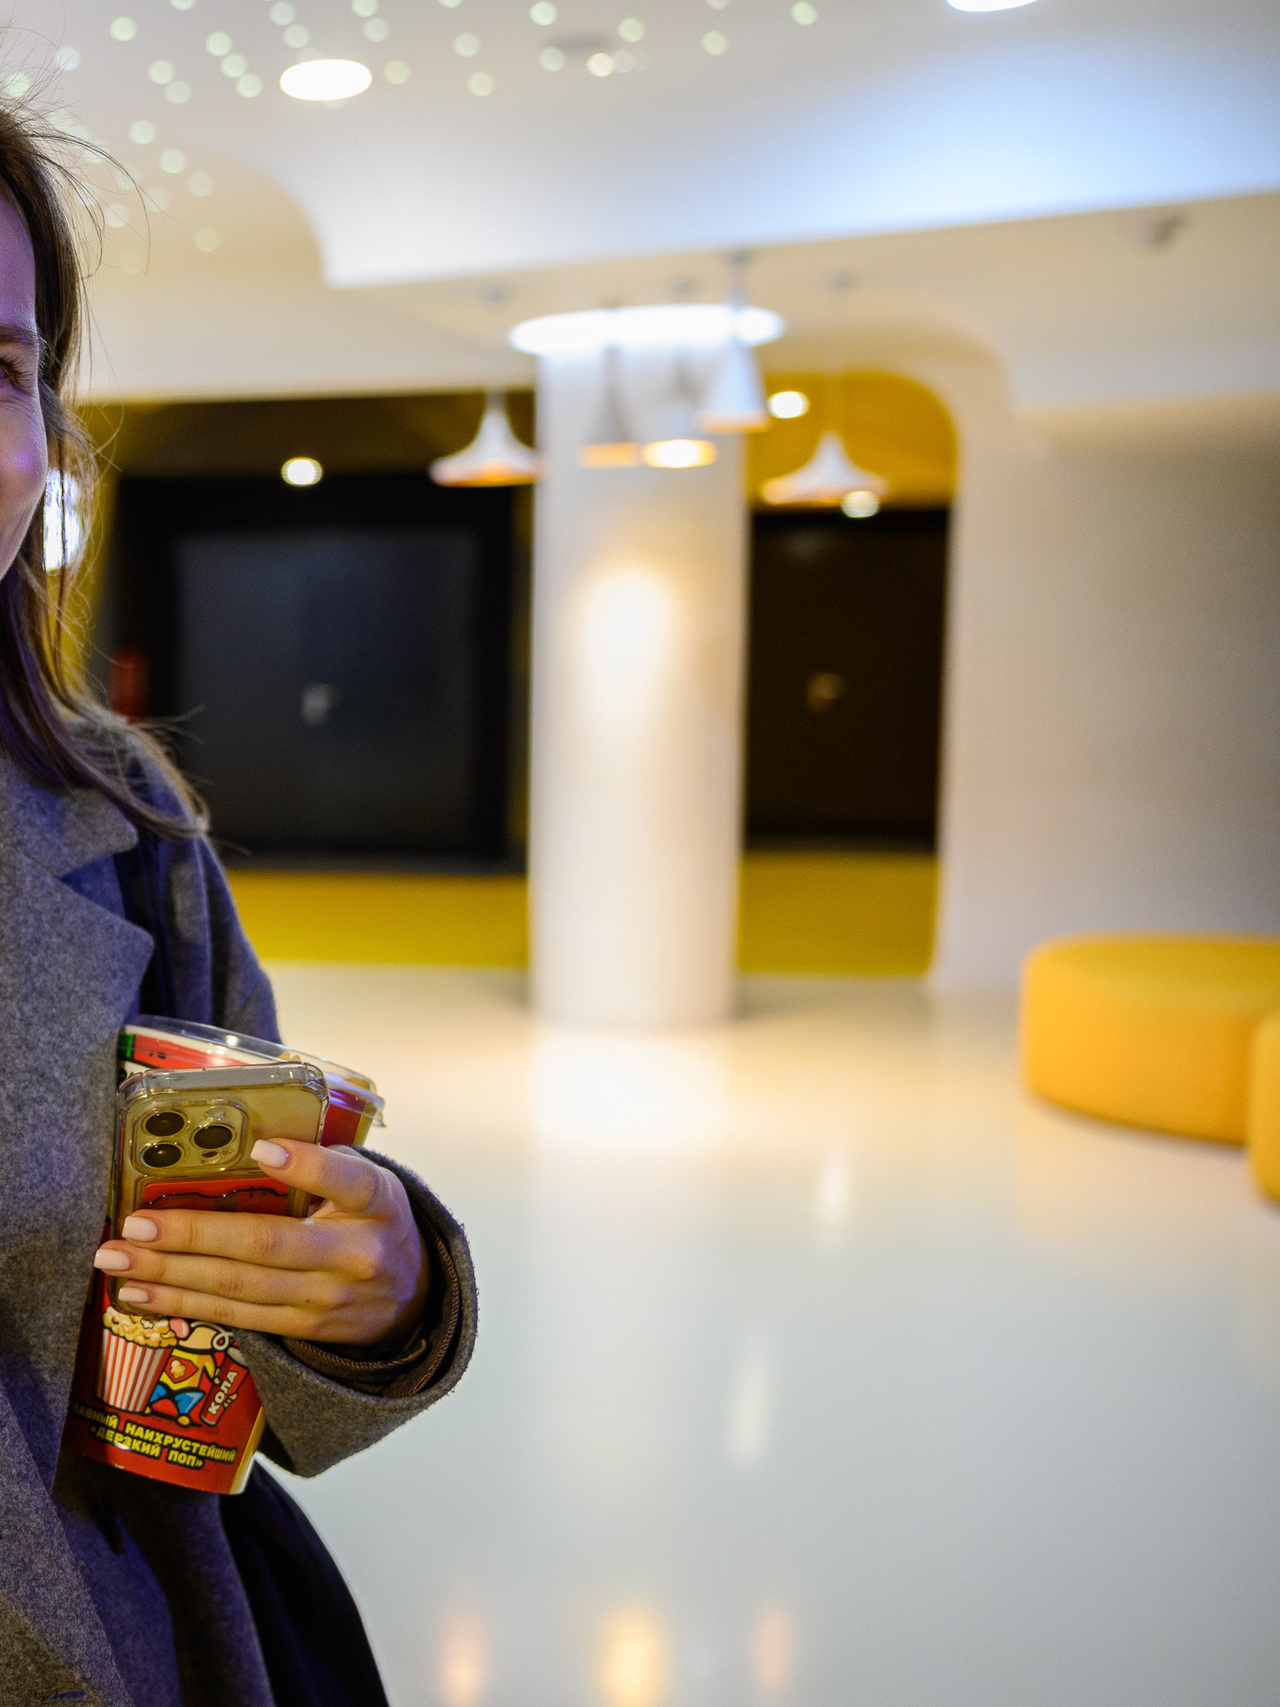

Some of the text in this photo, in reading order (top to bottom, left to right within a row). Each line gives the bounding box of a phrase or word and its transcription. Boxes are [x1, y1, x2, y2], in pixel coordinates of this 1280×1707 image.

[207, 1371, 238, 1415] КОЛА
[124, 1422, 237, 1462] НАИХРУСТЕЙШИЙ
[168, 1450, 204, 1468] ПОП»
